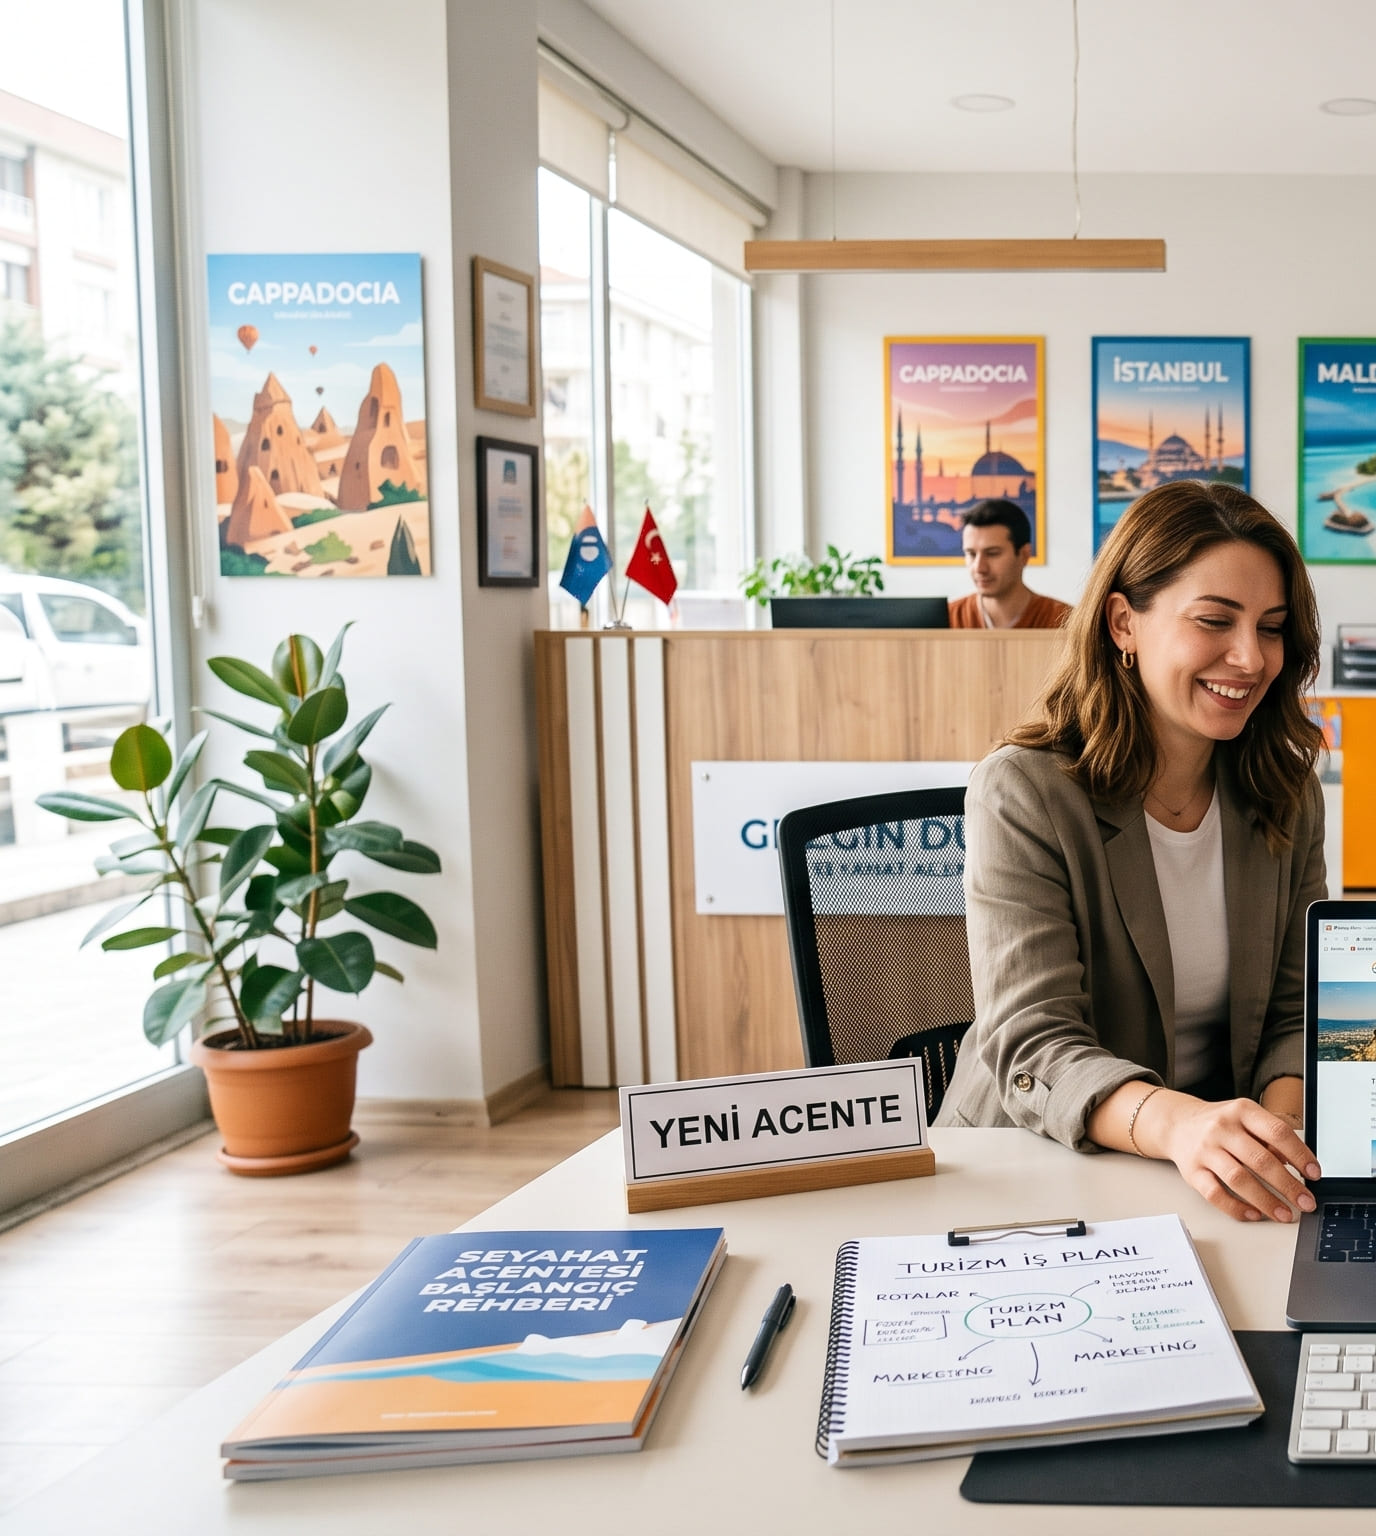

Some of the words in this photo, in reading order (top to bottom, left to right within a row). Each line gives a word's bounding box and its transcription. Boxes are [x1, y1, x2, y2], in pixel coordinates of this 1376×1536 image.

[228, 281, 401, 305] CAPPADOCIA
[899, 364, 1028, 383] CAPPADOCIA
[1113, 356, 1229, 383] İSTANBUL
[650, 1104, 740, 1149] YENİ
[752, 1094, 902, 1139] ACENTE
[455, 1249, 648, 1263] SEYAHAT
[897, 1258, 1006, 1274] TURİZM
[1024, 1252, 1047, 1267] İŞ
[1062, 1246, 1139, 1264] PLANI
[434, 1260, 645, 1279] ACENTESİ
[418, 1280, 639, 1298] BAŞLANGIÇ
[876, 1290, 960, 1301] ROTALAR
[423, 1293, 614, 1313] REHBERİ
[984, 1301, 1066, 1316] TURİZM
[989, 1313, 1063, 1329] PLAN
